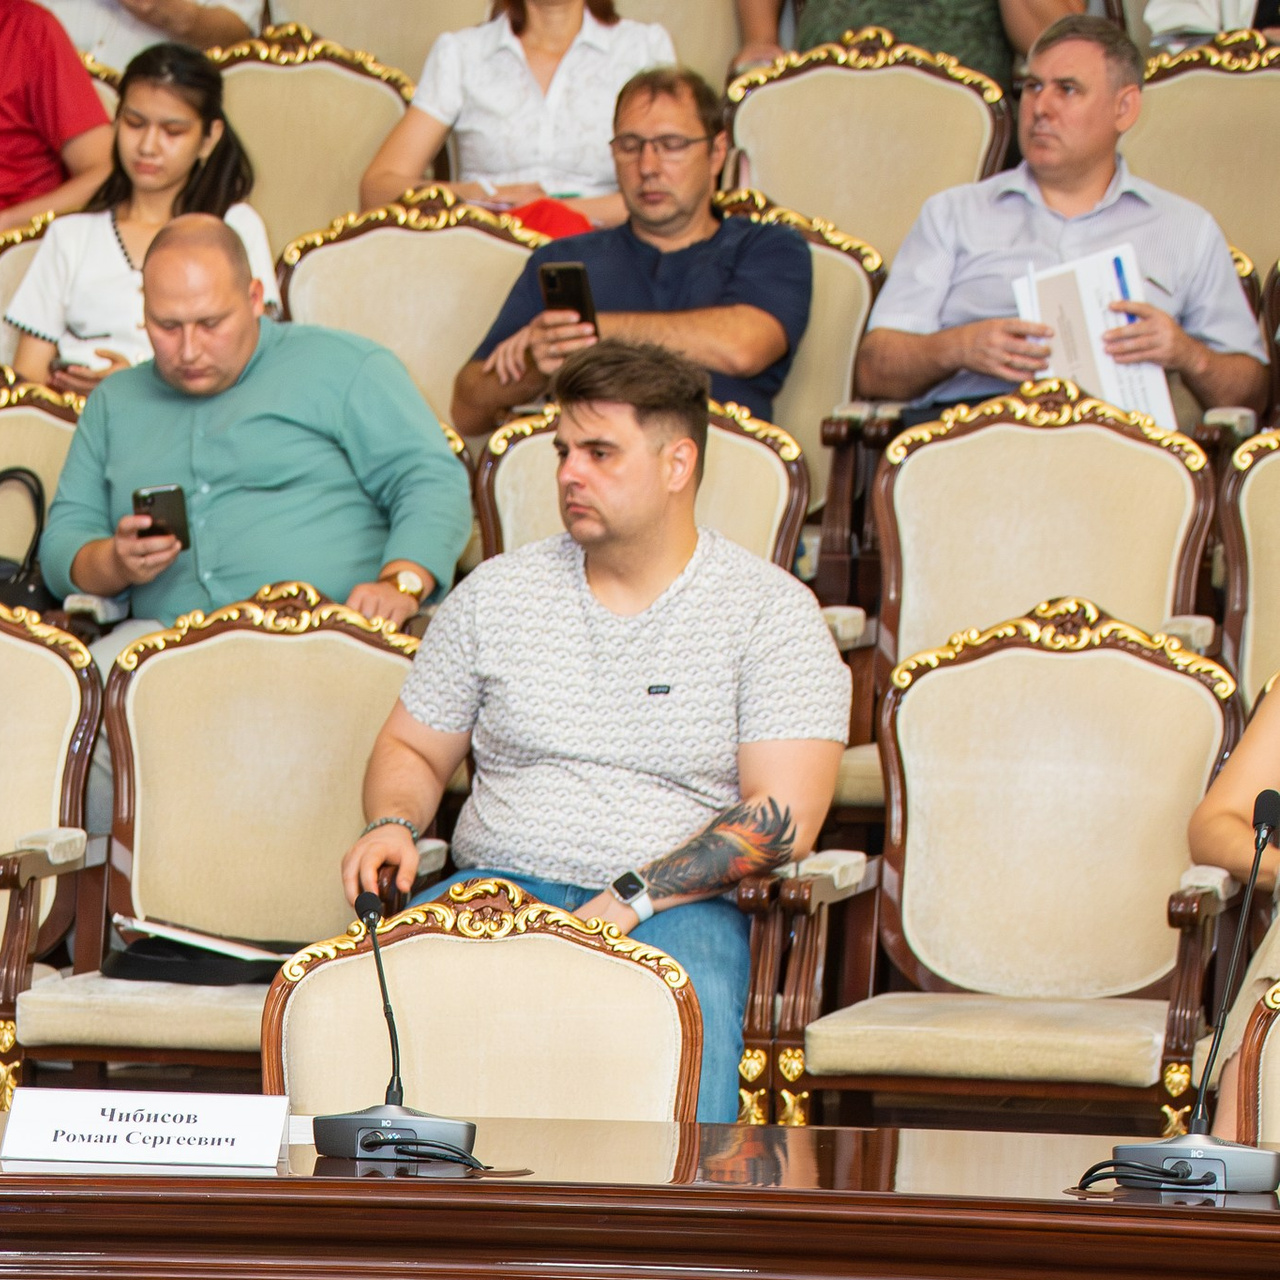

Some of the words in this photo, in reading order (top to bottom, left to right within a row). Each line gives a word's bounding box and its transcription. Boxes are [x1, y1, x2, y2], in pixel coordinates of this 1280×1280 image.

[100, 1107, 199, 1125] Чибисов
[52, 1129, 118, 1144] Роман
[125, 1131, 237, 1149] Сергеевич
